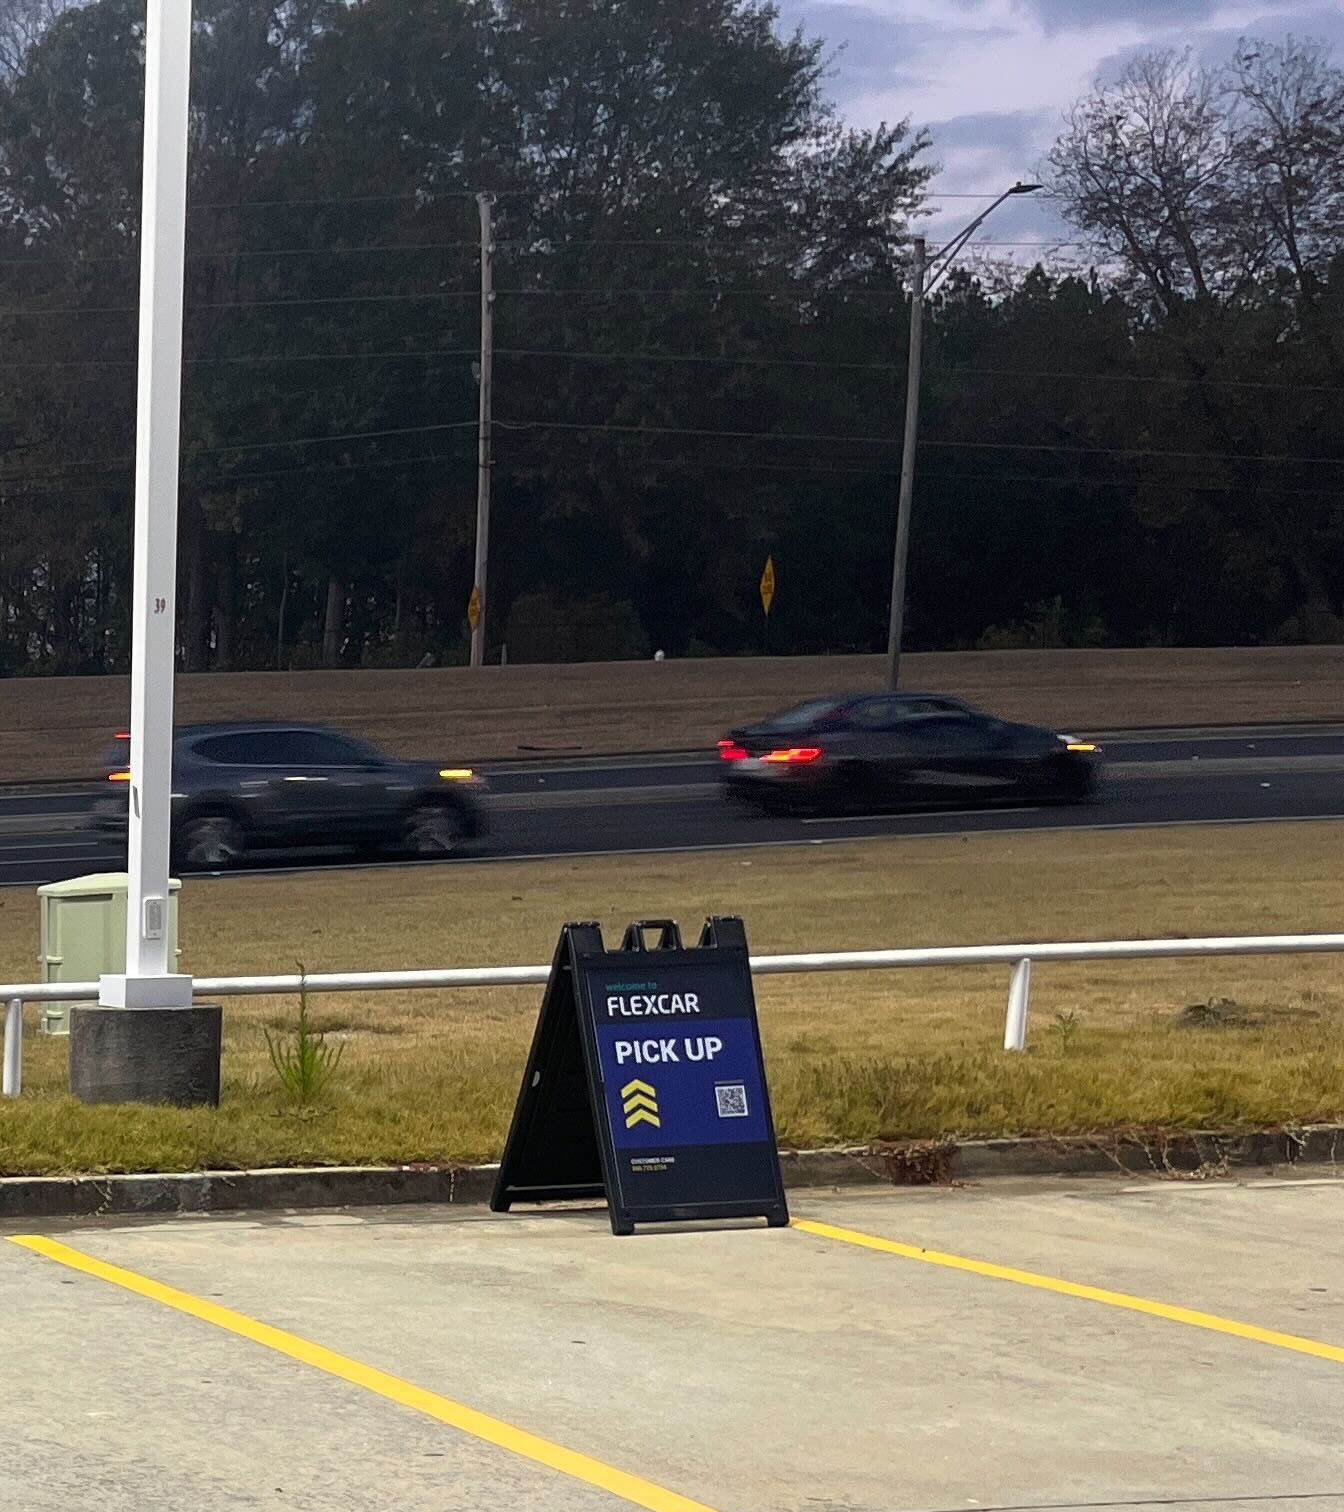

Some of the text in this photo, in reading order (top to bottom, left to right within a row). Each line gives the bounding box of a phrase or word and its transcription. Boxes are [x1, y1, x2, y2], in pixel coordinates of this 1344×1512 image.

[153, 597, 166, 614] 39
[606, 981, 657, 992] welcome to
[607, 993, 701, 1017] FLEXCAR
[615, 1036, 723, 1065] PICK UP
